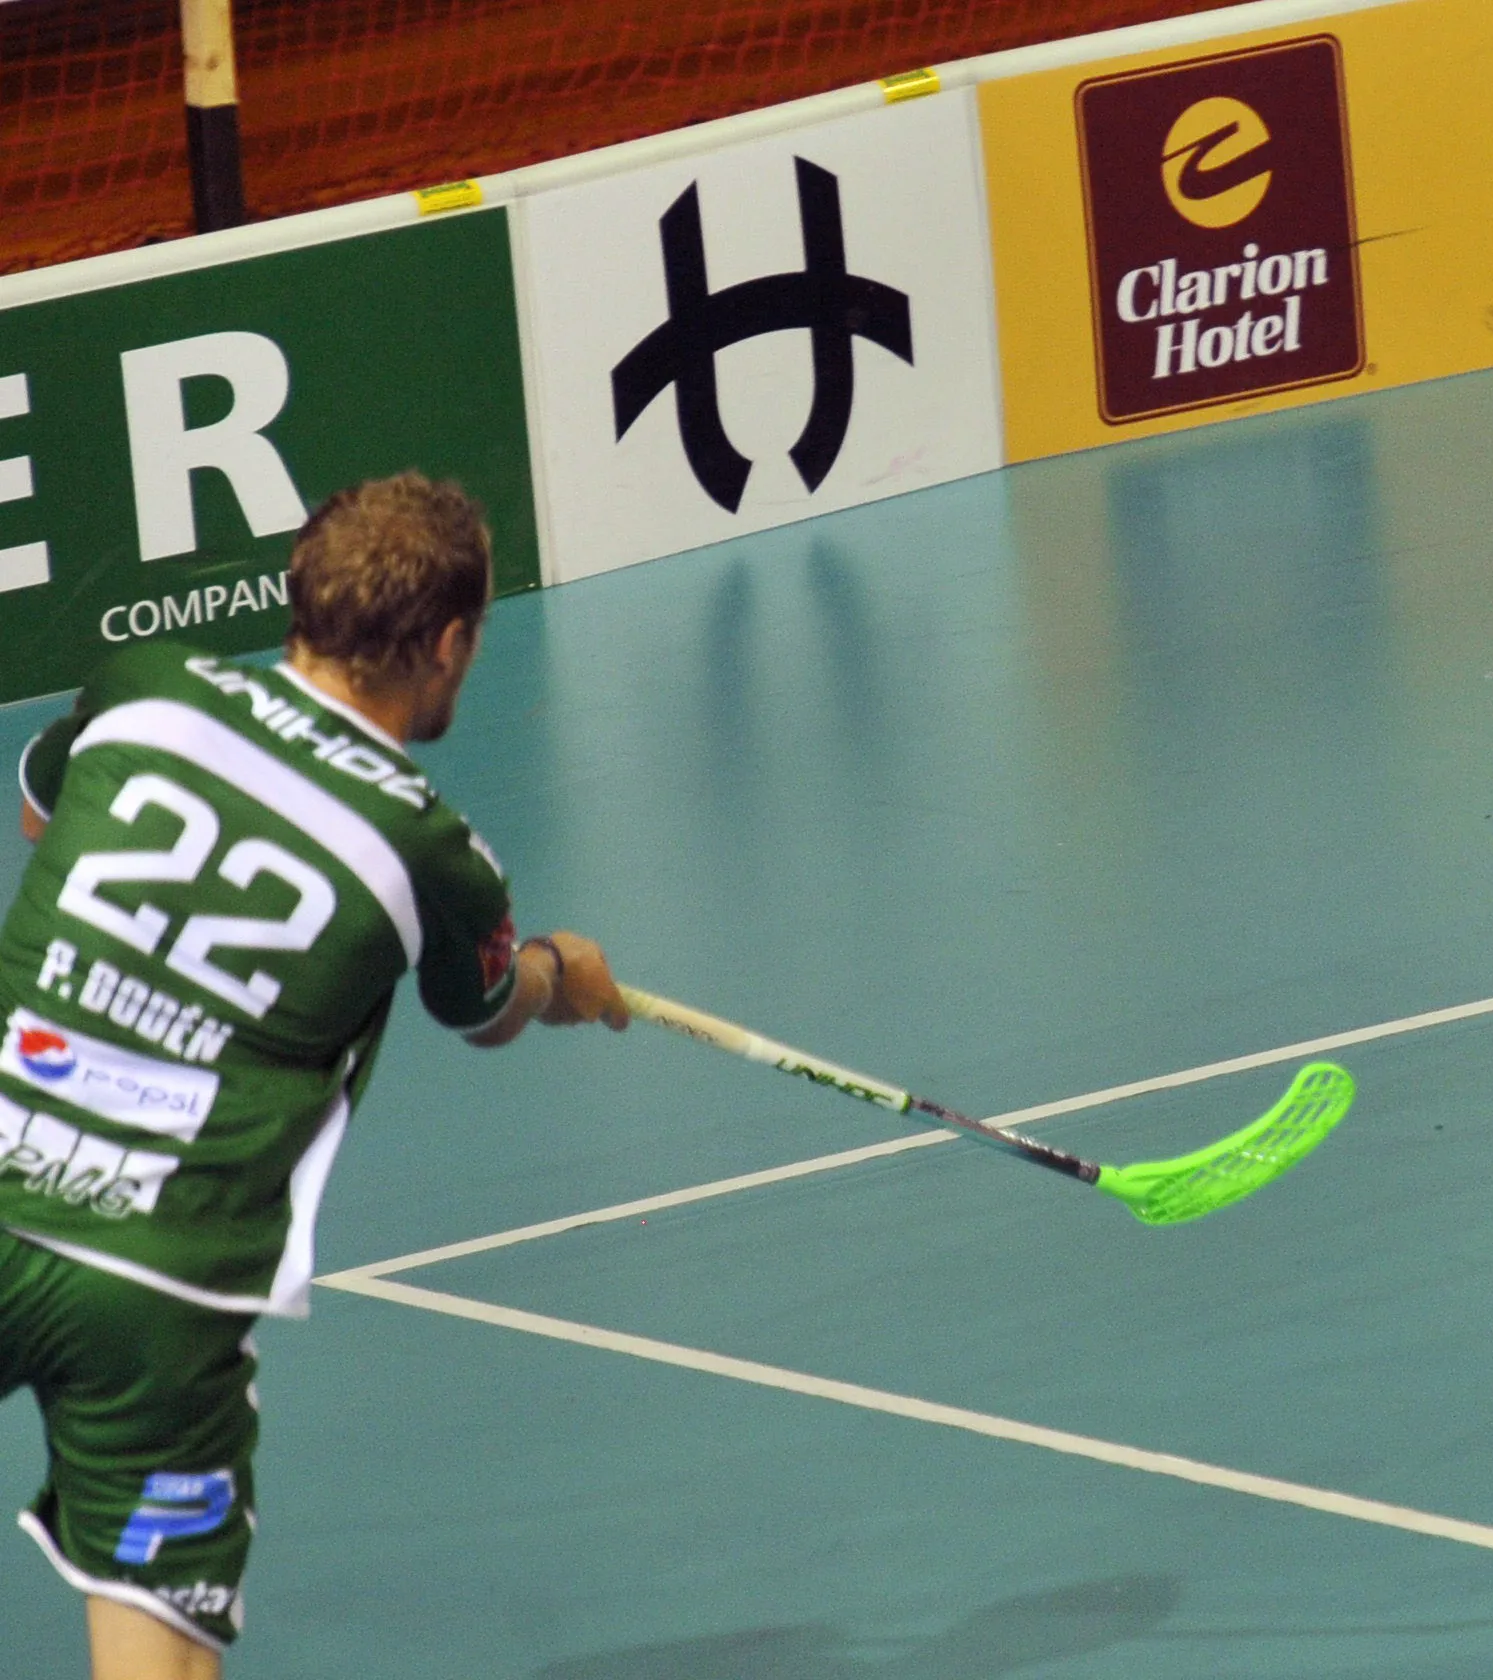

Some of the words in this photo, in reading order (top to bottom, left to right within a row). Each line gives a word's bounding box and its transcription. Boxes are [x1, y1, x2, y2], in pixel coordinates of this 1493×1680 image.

[1116, 243, 1329, 323] Clarion
[1152, 295, 1301, 379] Hotel
[100, 568, 292, 642] COMPAN
[56, 773, 337, 1019] 22
[0, 1143, 138, 1219] PMG
